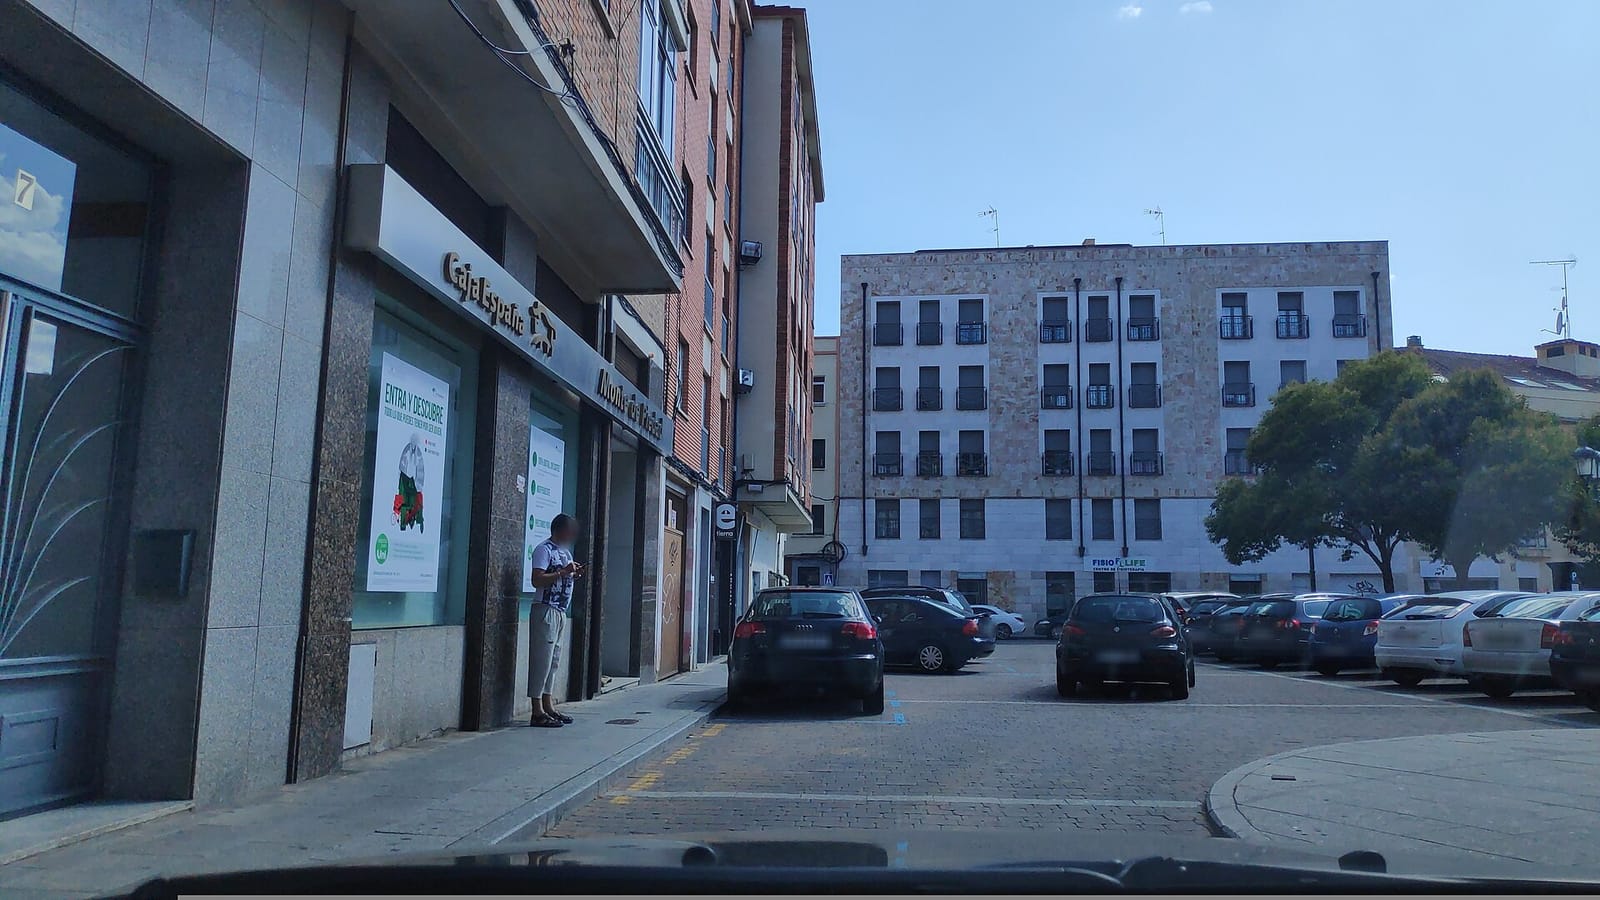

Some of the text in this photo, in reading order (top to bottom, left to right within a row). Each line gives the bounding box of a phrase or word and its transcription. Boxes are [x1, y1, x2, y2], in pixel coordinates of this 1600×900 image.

[18, 173, 34, 204] 7
[443, 251, 480, 303] Caja
[385, 382, 407, 411] ENTRA
[413, 395, 443, 425] DESCUBRE
[1125, 559, 1146, 567] LIFE
